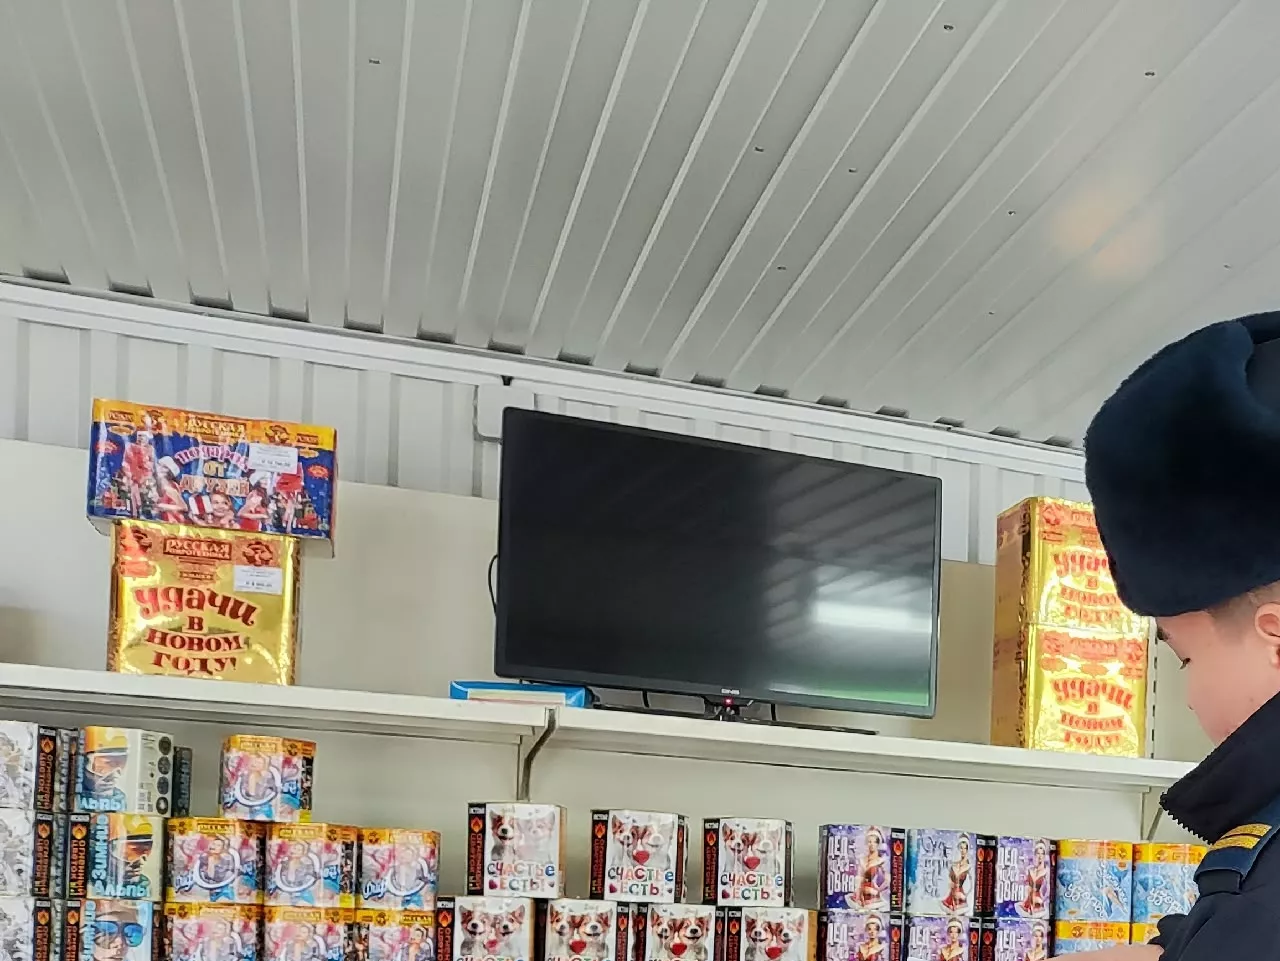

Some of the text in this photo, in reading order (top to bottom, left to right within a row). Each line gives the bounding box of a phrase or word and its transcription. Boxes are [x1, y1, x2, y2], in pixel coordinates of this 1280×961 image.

[165, 539, 231, 553] РУССКАЯ
[145, 628, 244, 651] НОВОМ
[151, 651, 238, 676] ГОДУ!
